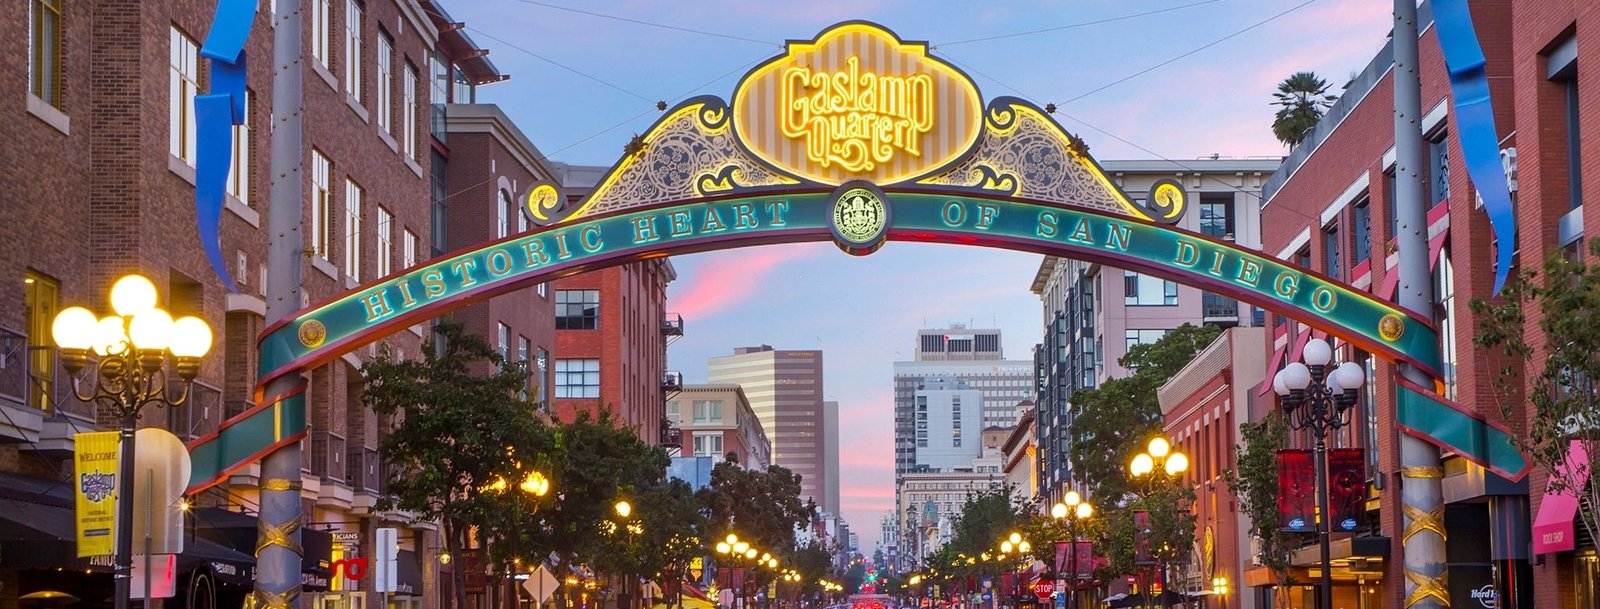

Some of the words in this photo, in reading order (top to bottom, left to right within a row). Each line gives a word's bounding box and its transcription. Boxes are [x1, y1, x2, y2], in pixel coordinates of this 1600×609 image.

[781, 55, 933, 138] Gaslamp
[808, 111, 920, 171] Quarter
[360, 225, 603, 322] HISTORIC
[631, 200, 789, 243] HEART
[943, 201, 1000, 230] OF
[1037, 211, 1132, 252] SAN
[1174, 239, 1337, 313] DIEGO
[79, 451, 117, 462] WELCOME
[1036, 584, 1053, 593] STOP
[1471, 589, 1490, 598] Hard
